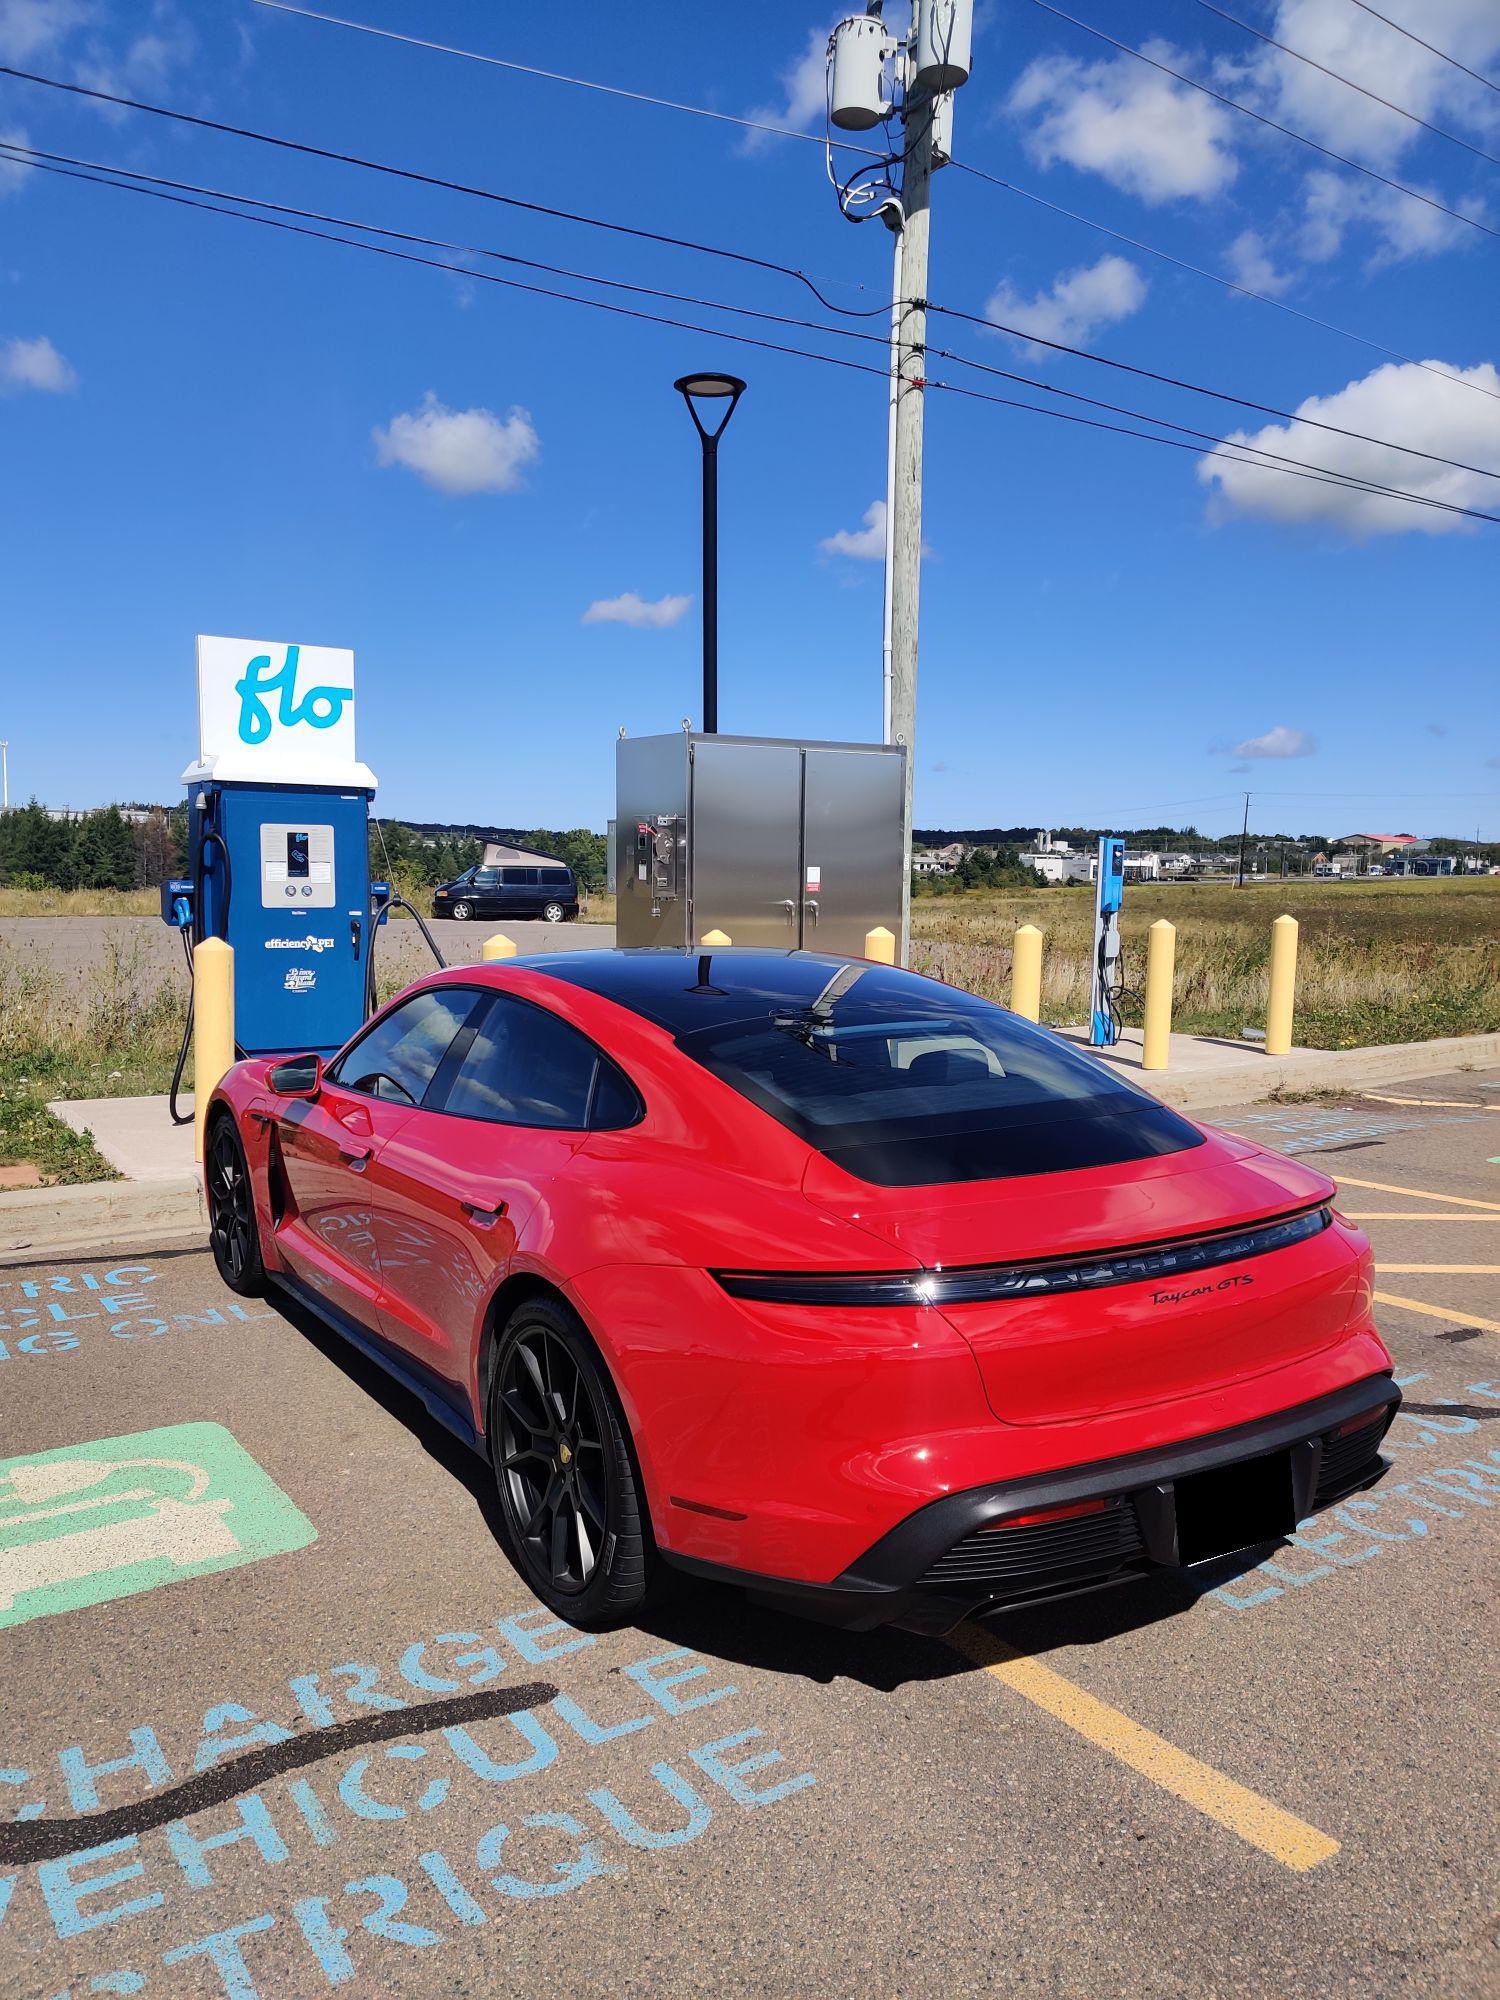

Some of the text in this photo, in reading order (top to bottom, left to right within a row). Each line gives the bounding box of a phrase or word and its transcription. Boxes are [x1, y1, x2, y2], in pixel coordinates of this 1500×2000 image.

[235, 645, 353, 745] flo
[264, 938, 311, 951] efficiency
[0, 1266, 157, 1298] RIC
[1149, 1274, 1254, 1305] Taycan GTS
[109, 1303, 280, 1340] ONL
[50, 1727, 817, 2000] TRIQUE
